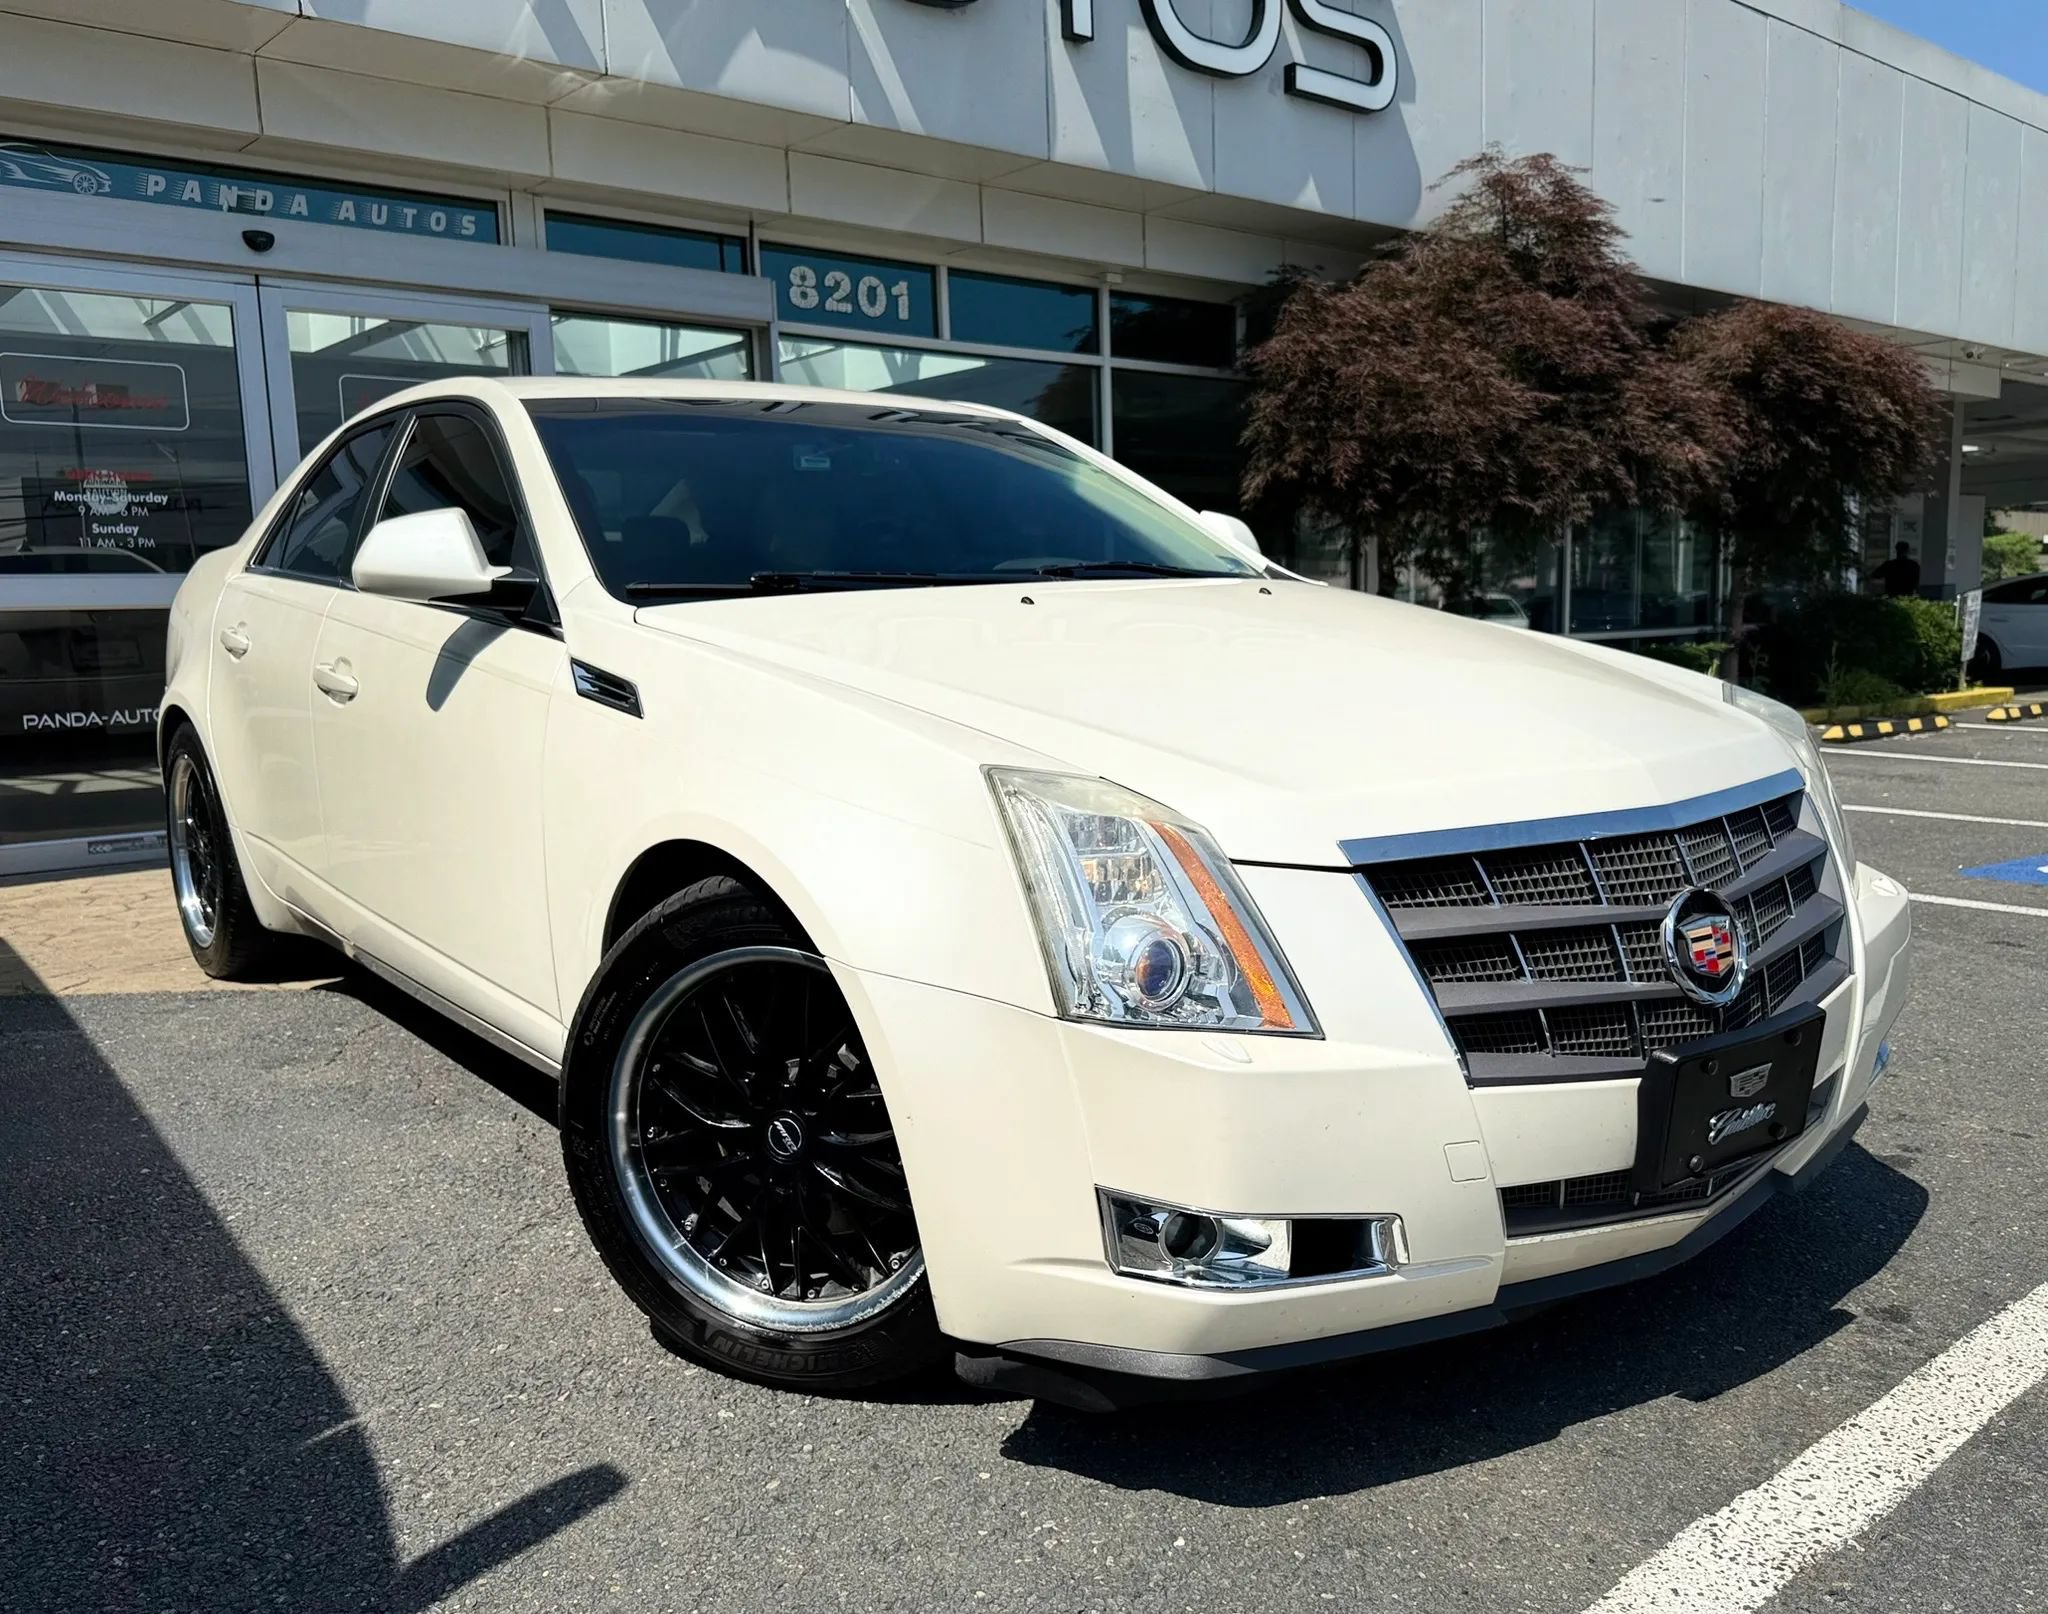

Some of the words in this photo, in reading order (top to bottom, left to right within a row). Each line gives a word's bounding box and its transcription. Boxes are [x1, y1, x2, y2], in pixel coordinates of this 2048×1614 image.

[142, 173, 308, 217] PANDA
[335, 200, 476, 236] AUTOS
[789, 265, 909, 321] 8201
[54, 490, 169, 506] Monday-Saturday
[78, 505, 86, 517] 9
[89, 505, 109, 517] AM
[120, 505, 128, 517] 6
[131, 505, 149, 517] PM
[91, 522, 140, 537] Sunday
[79, 536, 91, 549] 11
[96, 537, 117, 549] AM
[127, 537, 135, 549] 3
[138, 537, 156, 549] PM
[712, 1335, 841, 1372] MICHELIN
